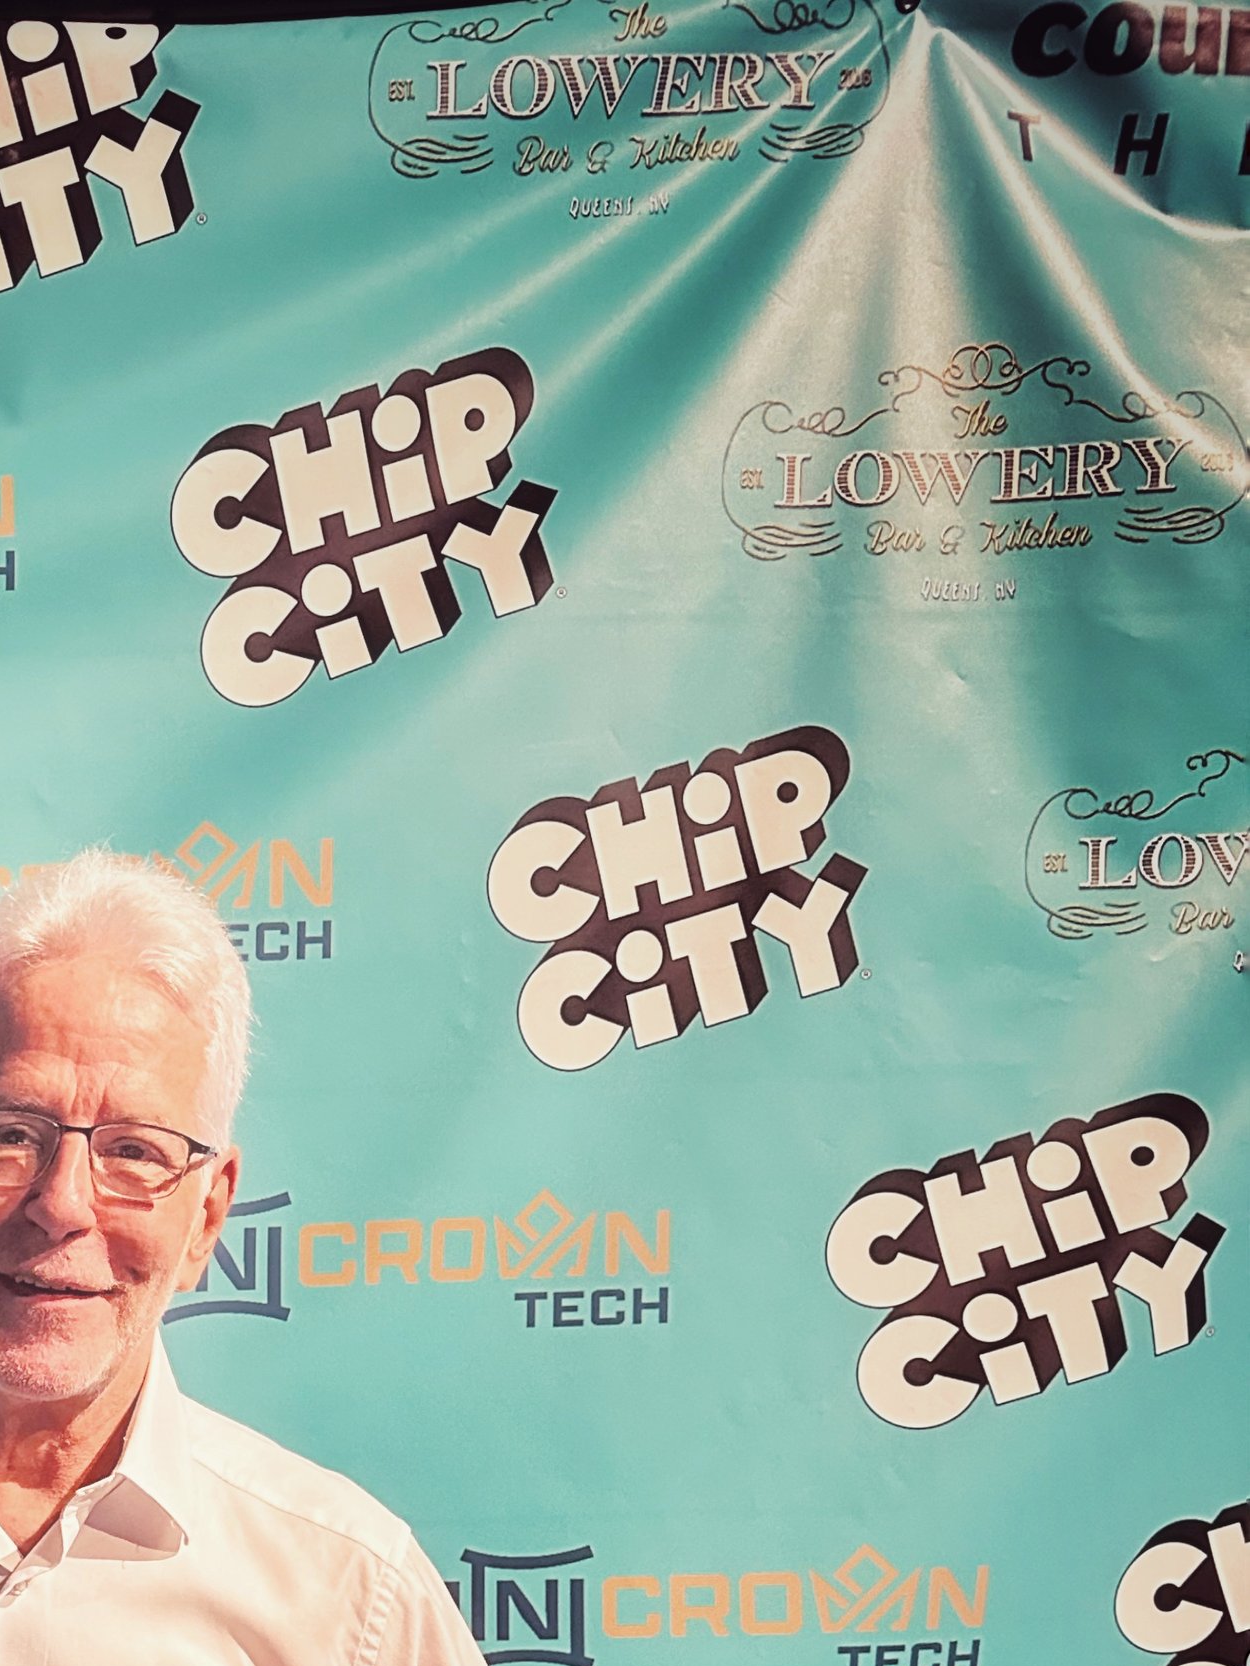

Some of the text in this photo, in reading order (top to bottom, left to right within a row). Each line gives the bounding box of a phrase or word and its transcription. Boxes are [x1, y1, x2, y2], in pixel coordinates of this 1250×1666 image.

[610, 4, 667, 42] The
[426, 49, 835, 120] LOWERY
[512, 135, 573, 176] Bar
[629, 126, 740, 171] Kitchen
[952, 400, 1008, 438] The
[774, 438, 1192, 508] LOWERY
[865, 520, 925, 556] Bar
[980, 513, 1092, 549] Kitchen
[1169, 901, 1235, 935] Bar
[222, 919, 332, 962] ECH
[298, 1188, 671, 1288] CROWN
[514, 1287, 669, 1328] TECH
[601, 1543, 990, 1640] CROWN
